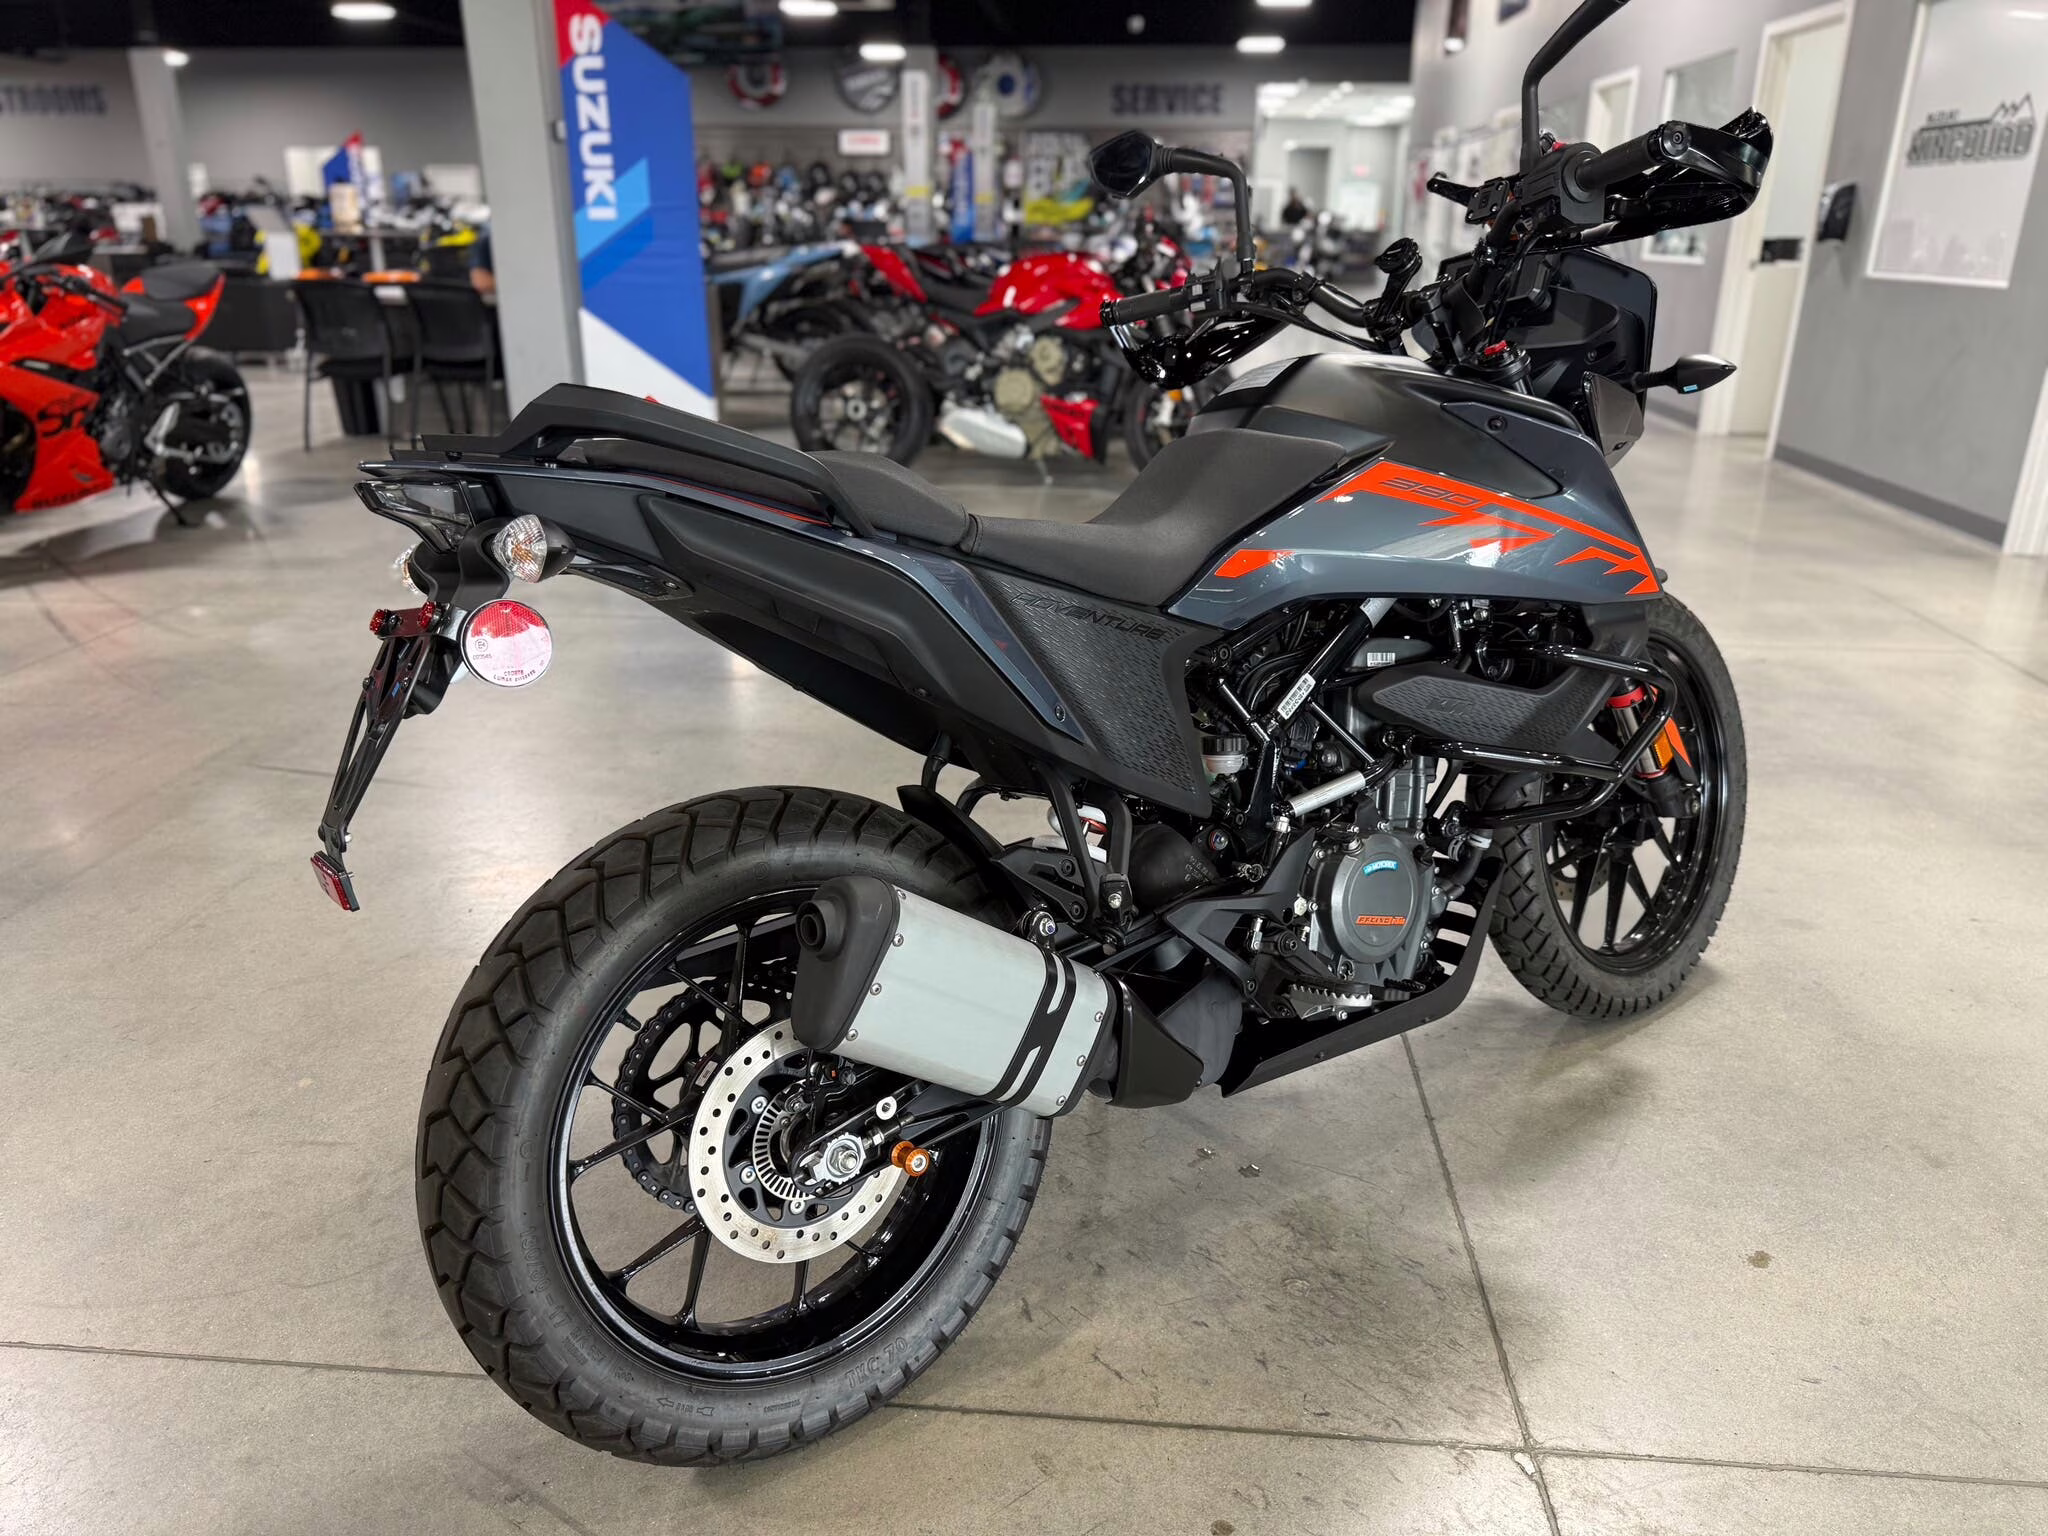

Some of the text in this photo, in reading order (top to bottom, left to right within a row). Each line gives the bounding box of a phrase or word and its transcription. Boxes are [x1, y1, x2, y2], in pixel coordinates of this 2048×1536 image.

[569, 13, 618, 221] SUZUKI
[1111, 84, 1222, 115] SERVICE
[1378, 477, 1482, 508] 390
[1009, 592, 1167, 640] ADVENTURE
[845, 1336, 910, 1388] TKC 70
